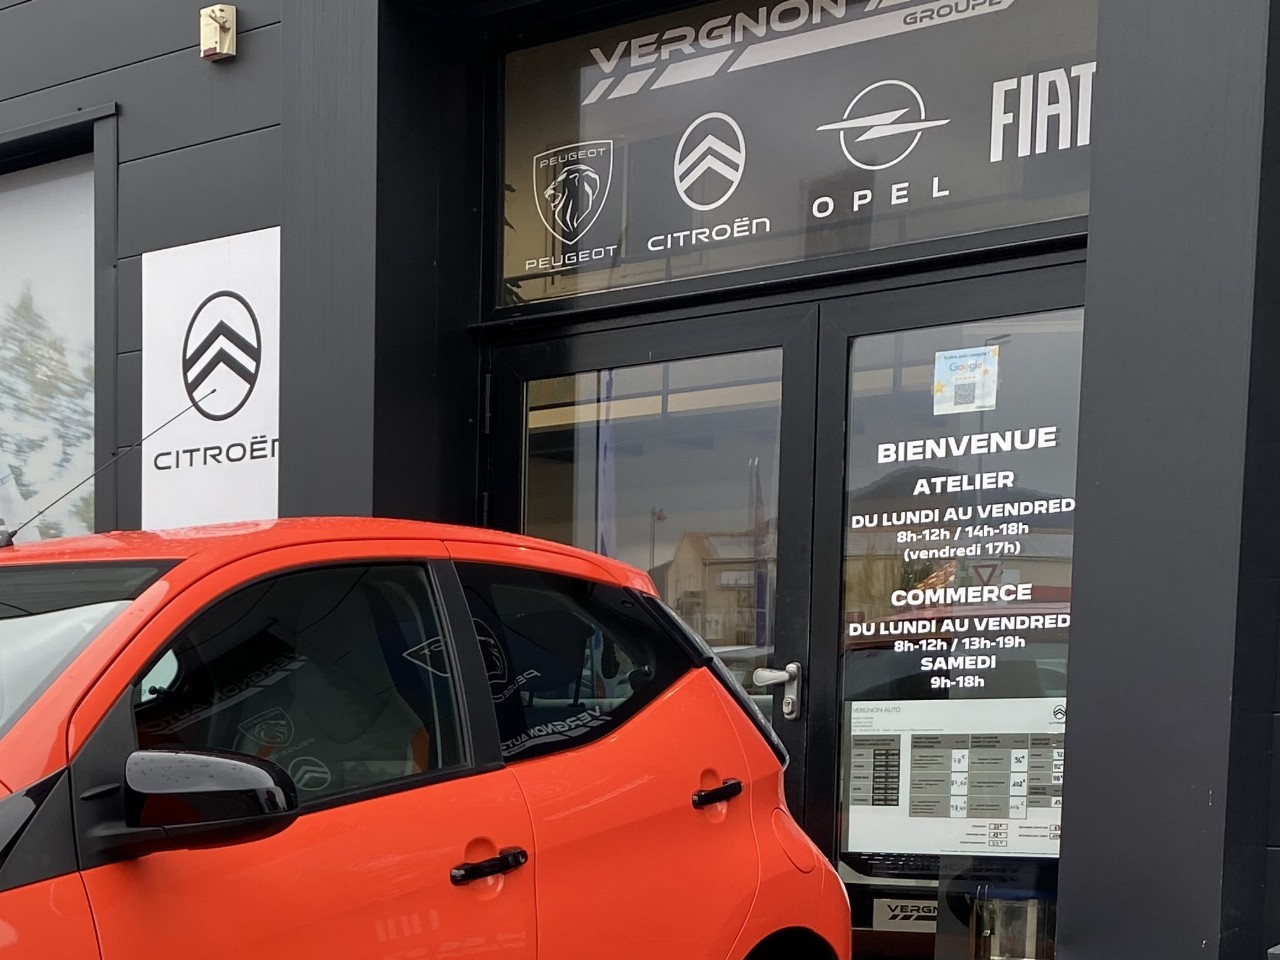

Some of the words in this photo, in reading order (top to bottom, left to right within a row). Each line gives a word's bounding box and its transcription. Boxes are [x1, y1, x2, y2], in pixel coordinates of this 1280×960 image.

[590, 0, 847, 73] VERGNON
[989, 61, 1097, 163] FIAT
[539, 148, 606, 169] PEUGEOT
[811, 176, 951, 219] OPEL
[525, 245, 618, 271] PEUGEOT
[949, 360, 983, 372] Google
[877, 426, 1058, 464] BIENVENUE
[912, 471, 1015, 496] ATELIER
[851, 513, 878, 529] DU
[882, 509, 939, 526] LUNDI
[943, 506, 972, 522] AU
[896, 527, 950, 544] 8h-12h
[953, 526, 962, 541] /
[964, 522, 1029, 538] 14h-18h
[903, 543, 981, 562] (vendredi
[985, 540, 1021, 556] 17h)
[890, 583, 1033, 607] COMMERCE
[848, 622, 875, 636] DU
[879, 619, 937, 635] LUNDI
[940, 617, 969, 632] AU
[893, 639, 947, 653] 8h-12h
[950, 638, 958, 652] /
[961, 635, 1026, 650] 13h-19h
[920, 655, 997, 671] SAMEDI
[930, 674, 985, 689] 9h-18h
